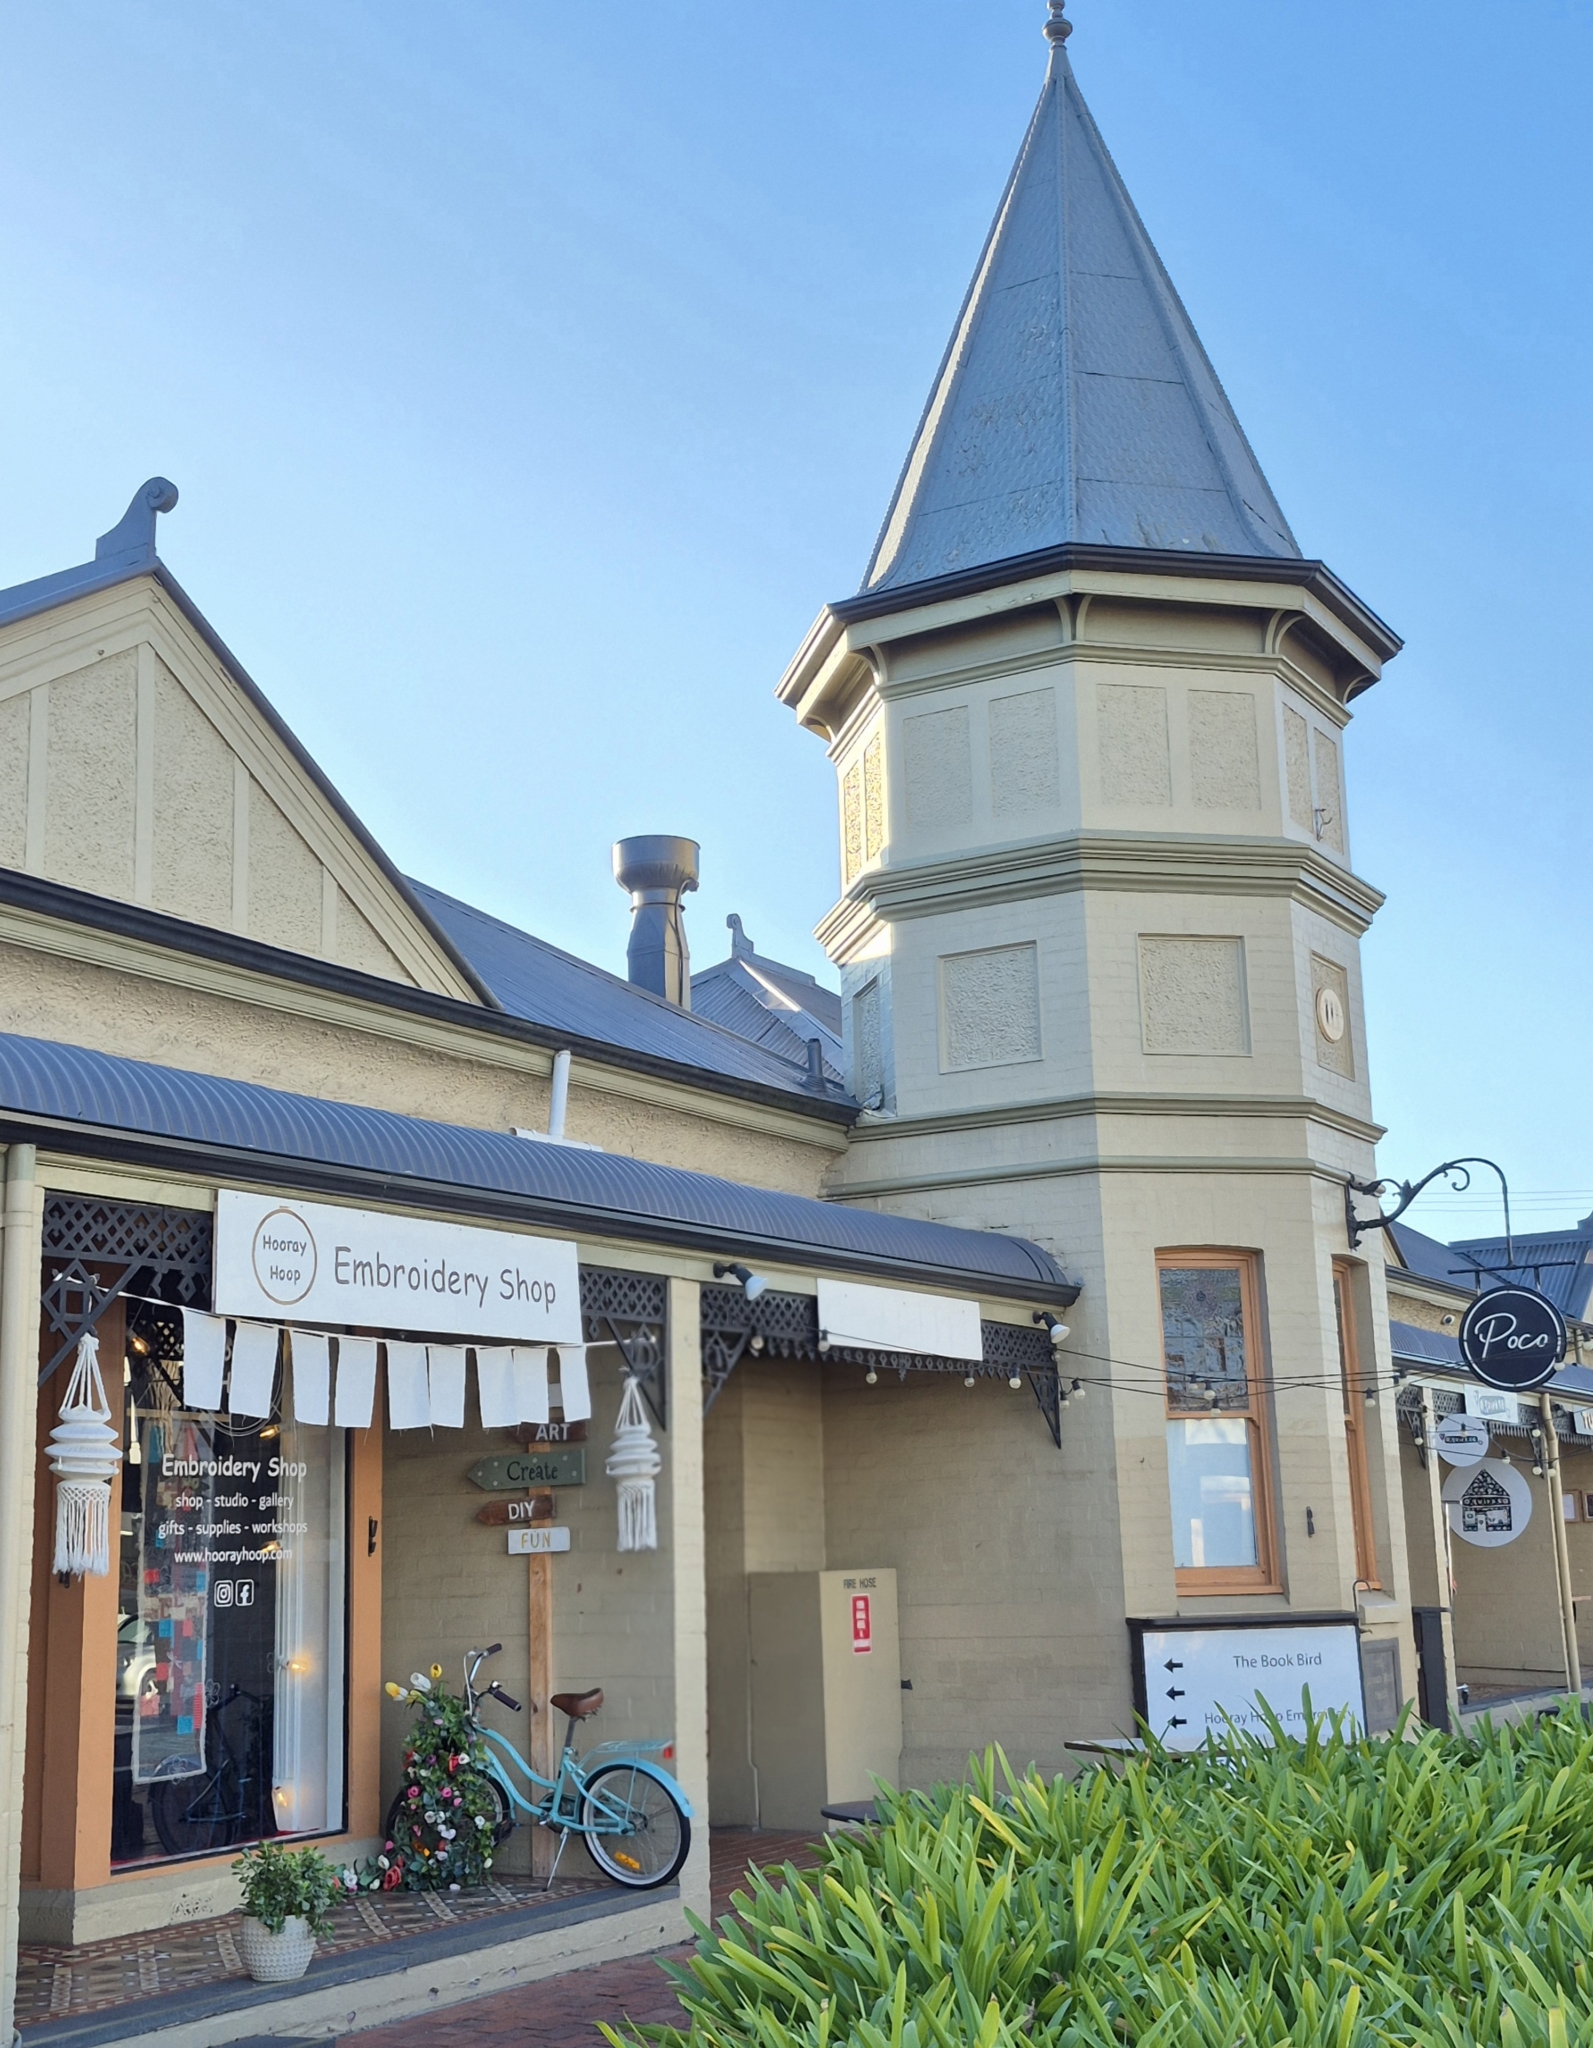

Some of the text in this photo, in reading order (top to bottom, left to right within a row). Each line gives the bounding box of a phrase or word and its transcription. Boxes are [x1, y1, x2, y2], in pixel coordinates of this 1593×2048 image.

[262, 1235, 307, 1256] Hooray
[270, 1265, 301, 1285] Hoop
[335, 1246, 556, 1314] Embroidery Shop
[1474, 1312, 1549, 1359] Poco
[535, 1423, 571, 1441] ART
[162, 1453, 307, 1483] Embroidery Shop
[507, 1461, 558, 1481] Create
[175, 1492, 204, 1510] shop
[214, 1493, 249, 1507] studio
[258, 1492, 294, 1510] gallery
[508, 1500, 536, 1520] DIY
[158, 1519, 185, 1539] gifts
[196, 1519, 242, 1538] supplies
[251, 1519, 308, 1536] workshops
[521, 1531, 552, 1549] FUN
[174, 1546, 293, 1565] www.hoorayhoop.com
[859, 1577, 876, 1589] HOSE
[1233, 1652, 1322, 1669] The Book Bird
